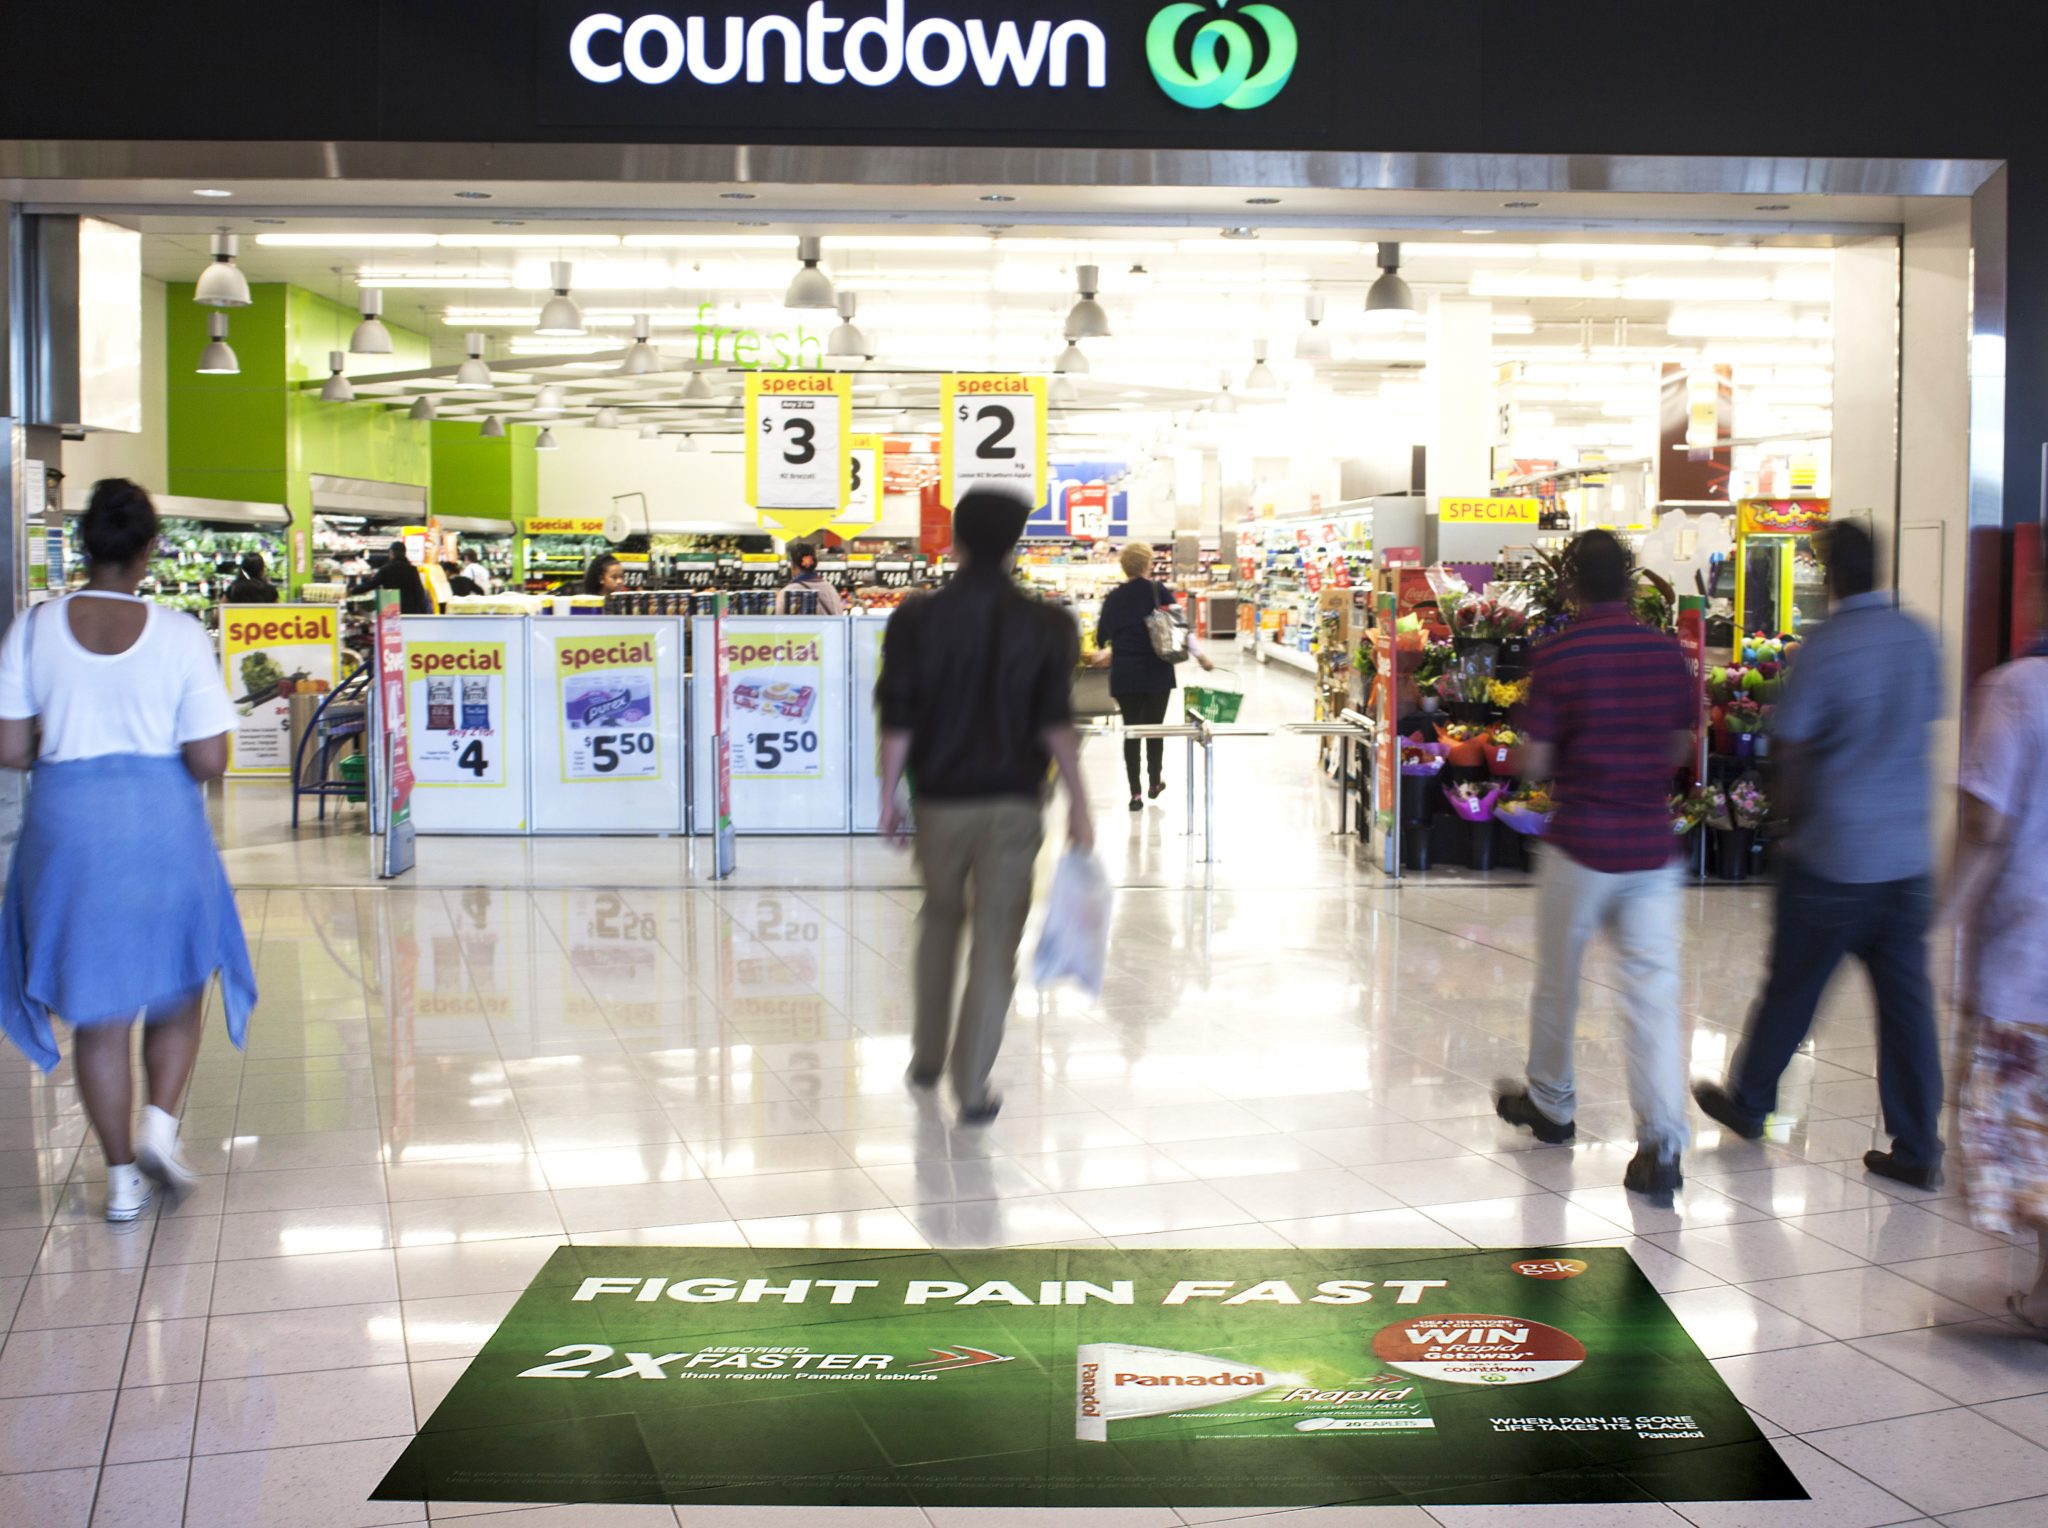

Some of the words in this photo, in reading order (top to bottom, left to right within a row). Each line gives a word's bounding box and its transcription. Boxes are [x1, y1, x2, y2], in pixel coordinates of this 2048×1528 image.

[569, 0, 1106, 87] countdown
[691, 302, 823, 370] fresh
[762, 377, 833, 394] special
[958, 377, 1029, 394] special
[1449, 502, 1530, 519] SPECIAL
[530, 520, 573, 532] special
[229, 616, 332, 646] special
[410, 649, 503, 674] special
[560, 641, 654, 669] special
[728, 640, 819, 666] special
[588, 697, 627, 721] purex
[1518, 1261, 1581, 1276] gsk
[571, 1277, 880, 1305] FIGHT
[903, 1280, 1134, 1306] PAIN
[1160, 1280, 1448, 1305] FAST
[1404, 1328, 1531, 1344] WIN
[698, 1346, 810, 1354] ABSORBED
[1446, 1344, 1520, 1353] Rapid
[684, 1354, 895, 1370] FASTER
[680, 1372, 721, 1380] than
[725, 1373, 790, 1381] regular
[795, 1372, 871, 1381] Panadol
[874, 1373, 938, 1381] tablets
[1114, 1372, 1266, 1387] Panadol
[1081, 1363, 1101, 1417] Panadol
[1281, 1386, 1415, 1406] Rapid
[1490, 1417, 1557, 1425] WHEN
[1559, 1417, 1606, 1425] PAIN
[1611, 1416, 1631, 1424] IS
[1635, 1416, 1694, 1424] GONE
[1493, 1424, 1536, 1432] LIFE
[1536, 1423, 1601, 1432] TAKES
[1602, 1423, 1632, 1431] ITS
[1635, 1422, 1699, 1430] PLACE
[1638, 1430, 1705, 1440] Panadol
